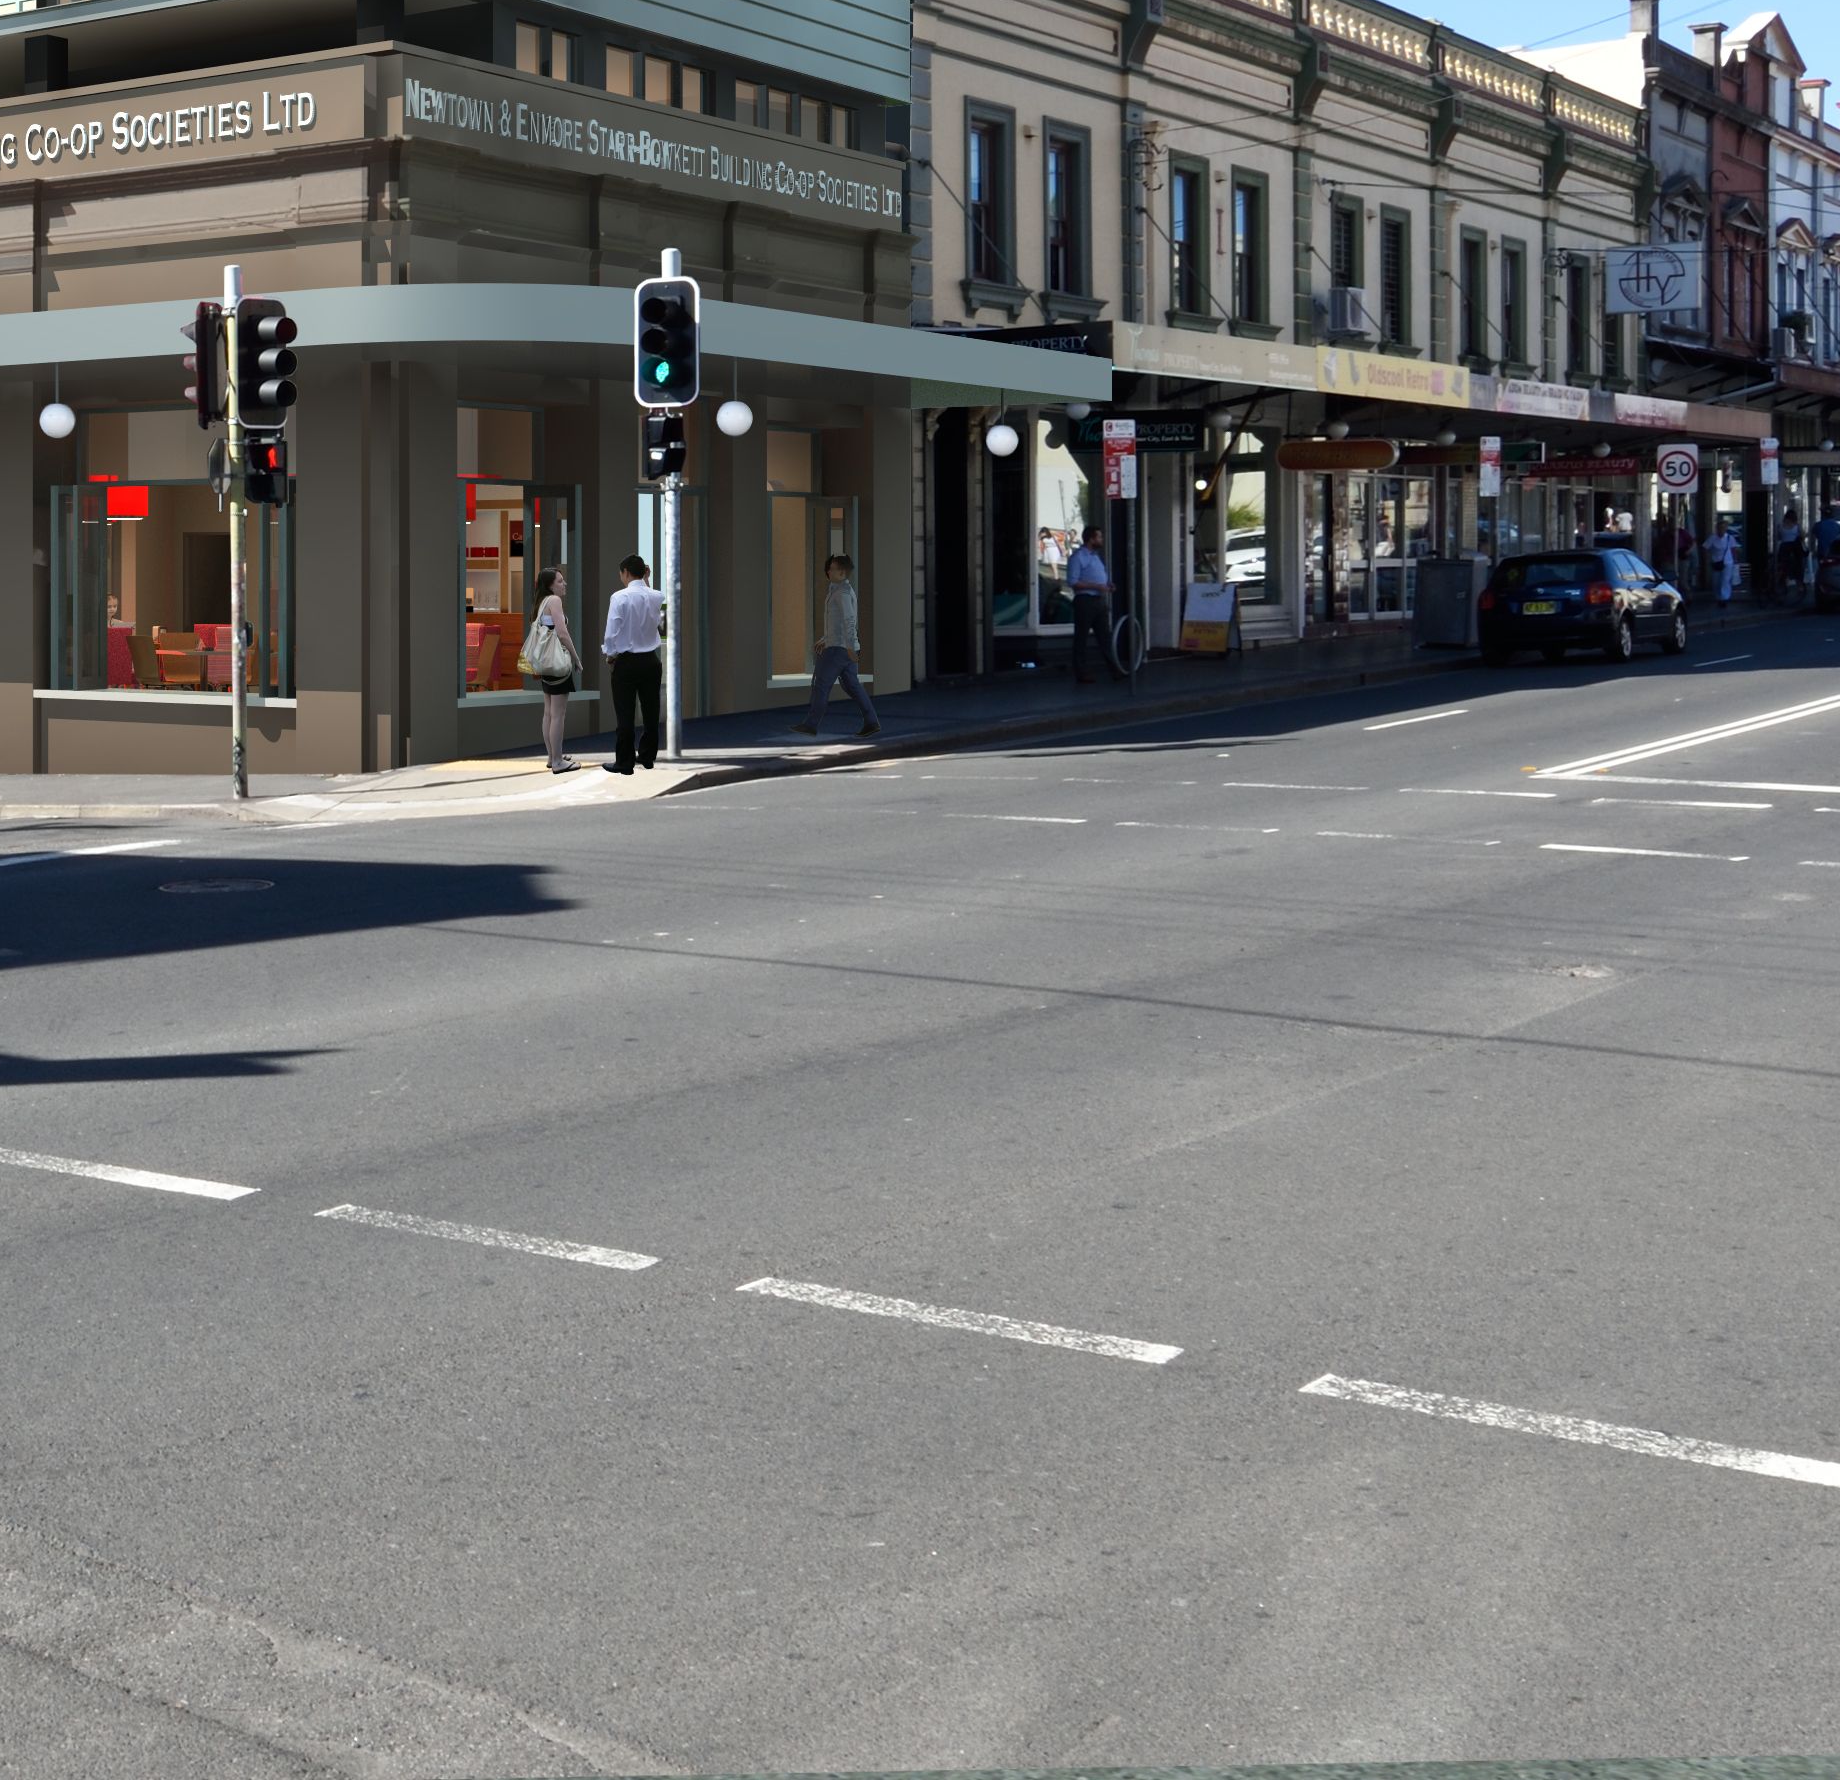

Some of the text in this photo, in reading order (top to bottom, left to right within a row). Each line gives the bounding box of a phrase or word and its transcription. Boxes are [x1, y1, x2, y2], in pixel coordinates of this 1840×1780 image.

[24, 121, 104, 163] CO-OP
[111, 98, 253, 150] SOCIETIES
[262, 91, 318, 132] LTD
[499, 99, 512, 138] &
[515, 101, 584, 155] ENMORE
[709, 145, 774, 193] BUILDING
[774, 160, 815, 201] CO-OP
[817, 170, 879, 214] SOCIETIES
[881, 183, 902, 218] LTD
[1665, 461, 1690, 477] 50
